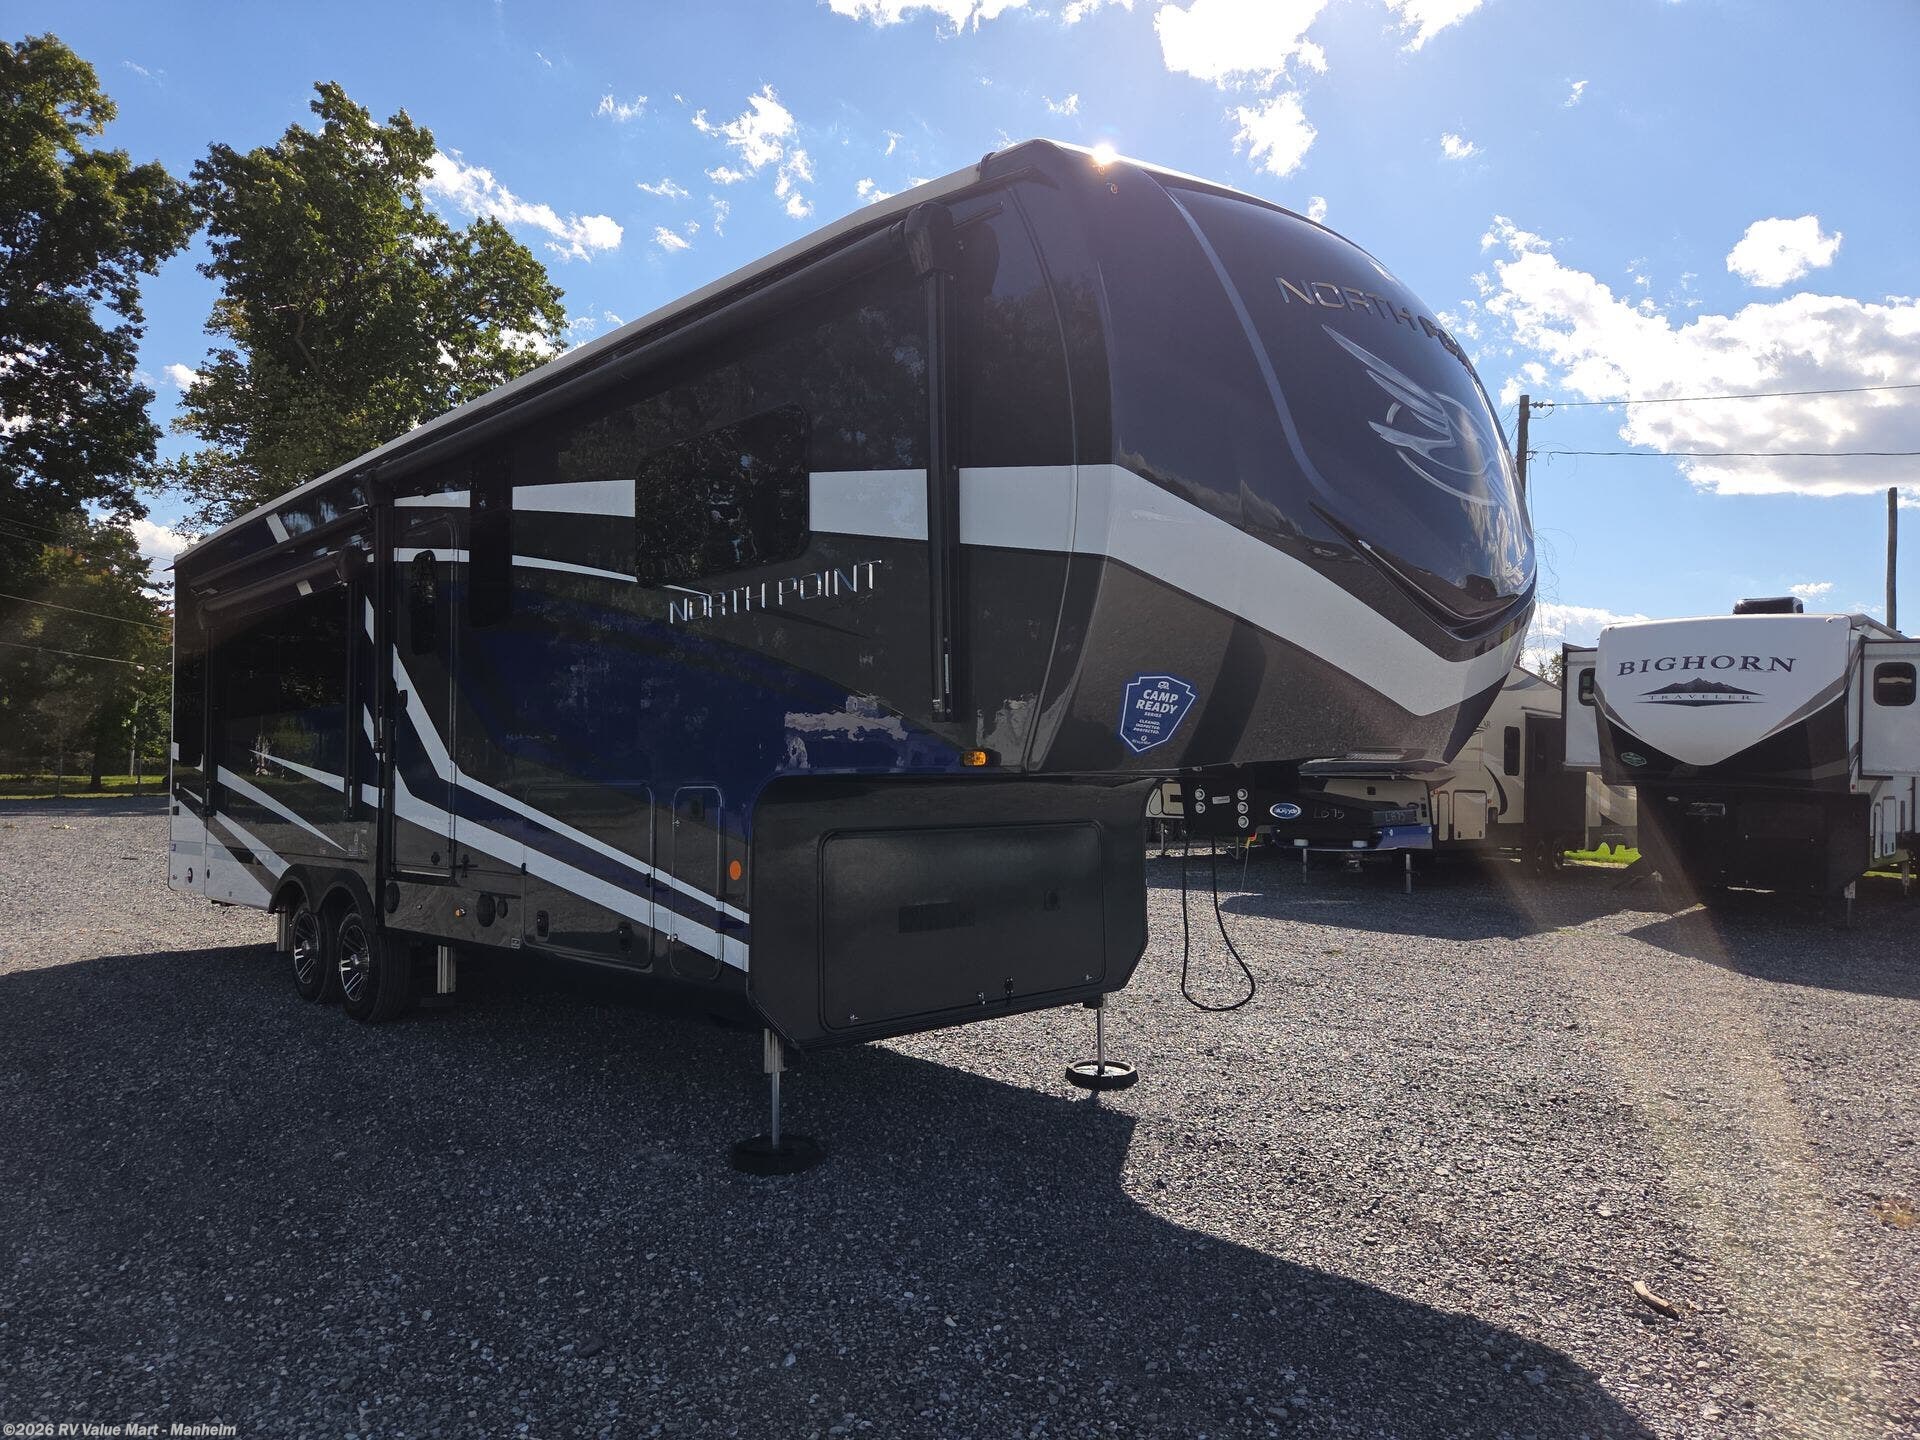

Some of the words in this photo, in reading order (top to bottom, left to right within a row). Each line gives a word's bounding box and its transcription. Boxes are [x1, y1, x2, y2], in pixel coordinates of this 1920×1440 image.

[1275, 276, 1418, 331] NORTH
[669, 583, 766, 624] NORTH
[778, 559, 882, 606] POINT
[1617, 655, 1797, 676] BIGHORN
[1136, 699, 1178, 714] READY
[1143, 689, 1179, 703] CAMP
